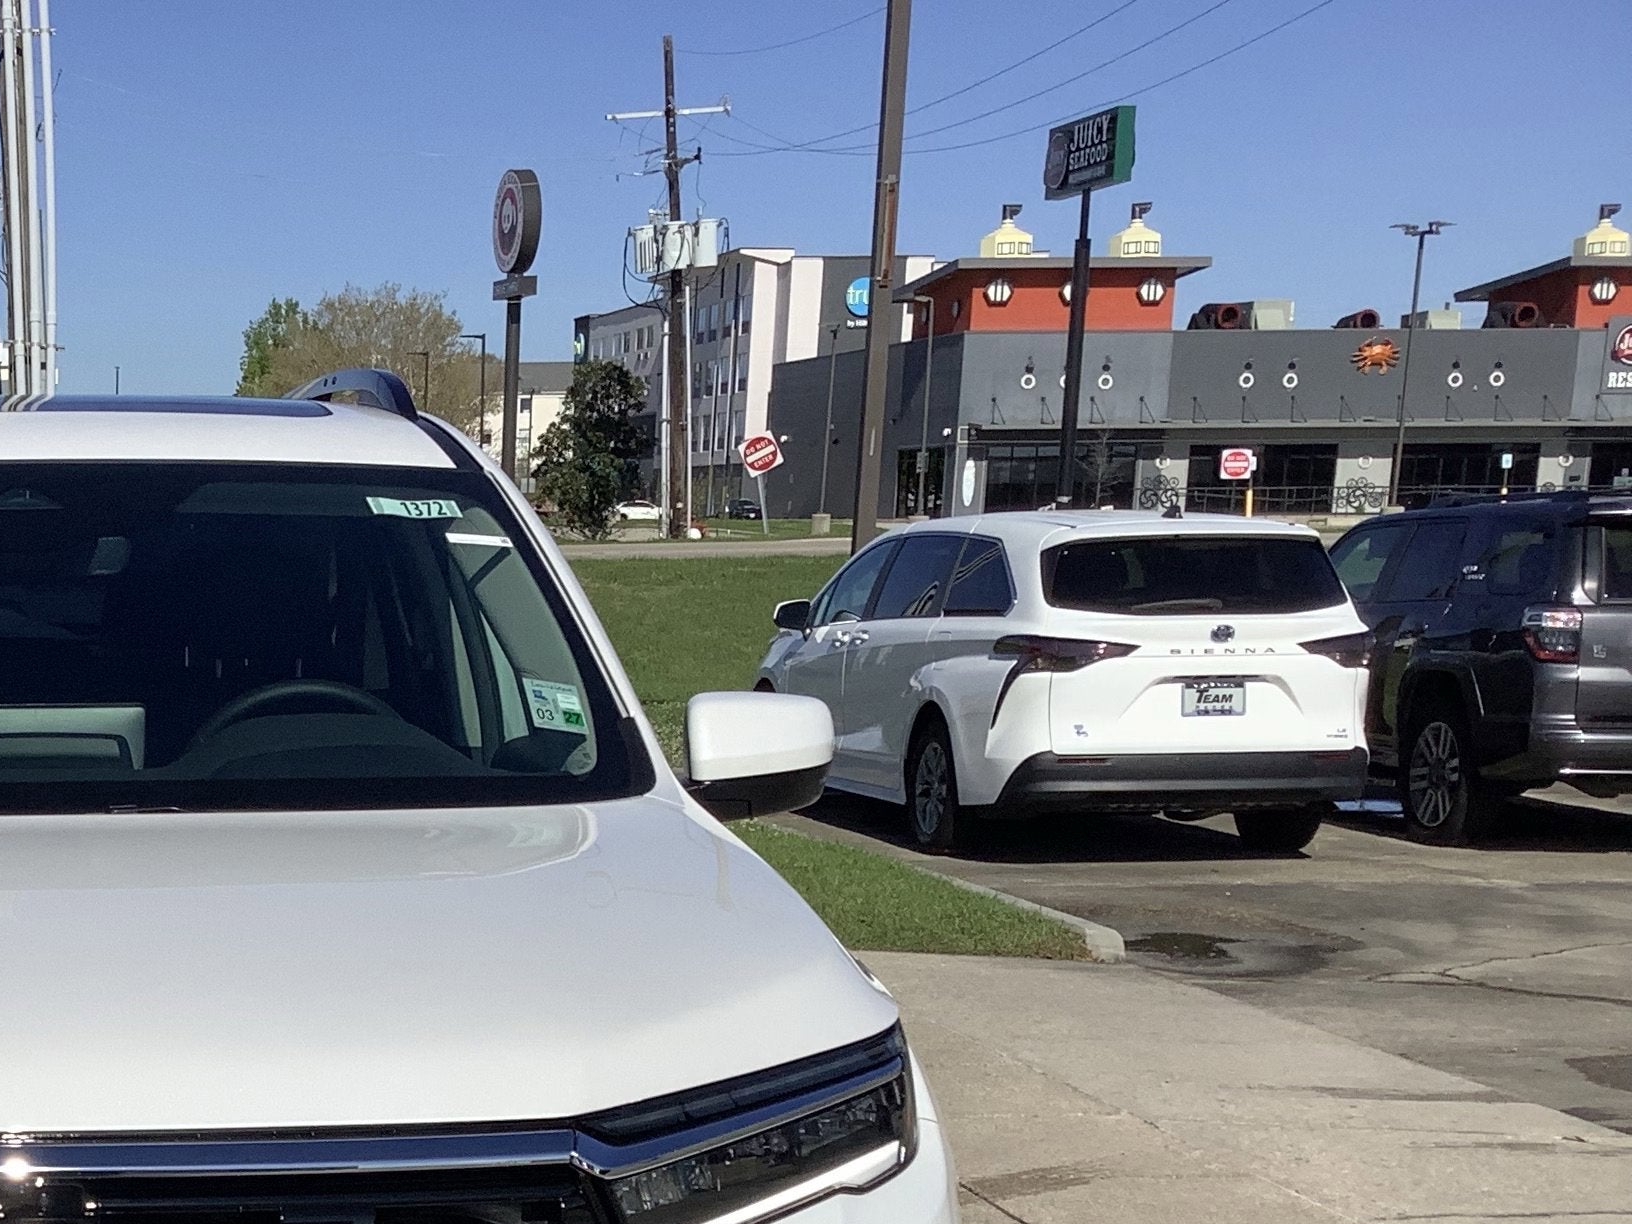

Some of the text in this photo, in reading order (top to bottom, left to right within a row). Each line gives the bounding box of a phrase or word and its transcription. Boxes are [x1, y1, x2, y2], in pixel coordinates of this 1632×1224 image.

[1069, 114, 1110, 151] JUICY
[1069, 143, 1108, 171] SEAFOOD
[745, 439, 769, 456] DO NOT
[753, 453, 774, 469] ENTER
[400, 501, 447, 516] 1372
[1169, 647, 1276, 655] SIENNA
[1195, 688, 1234, 704] TEAM
[536, 708, 555, 721] 03
[565, 711, 581, 725] 27
